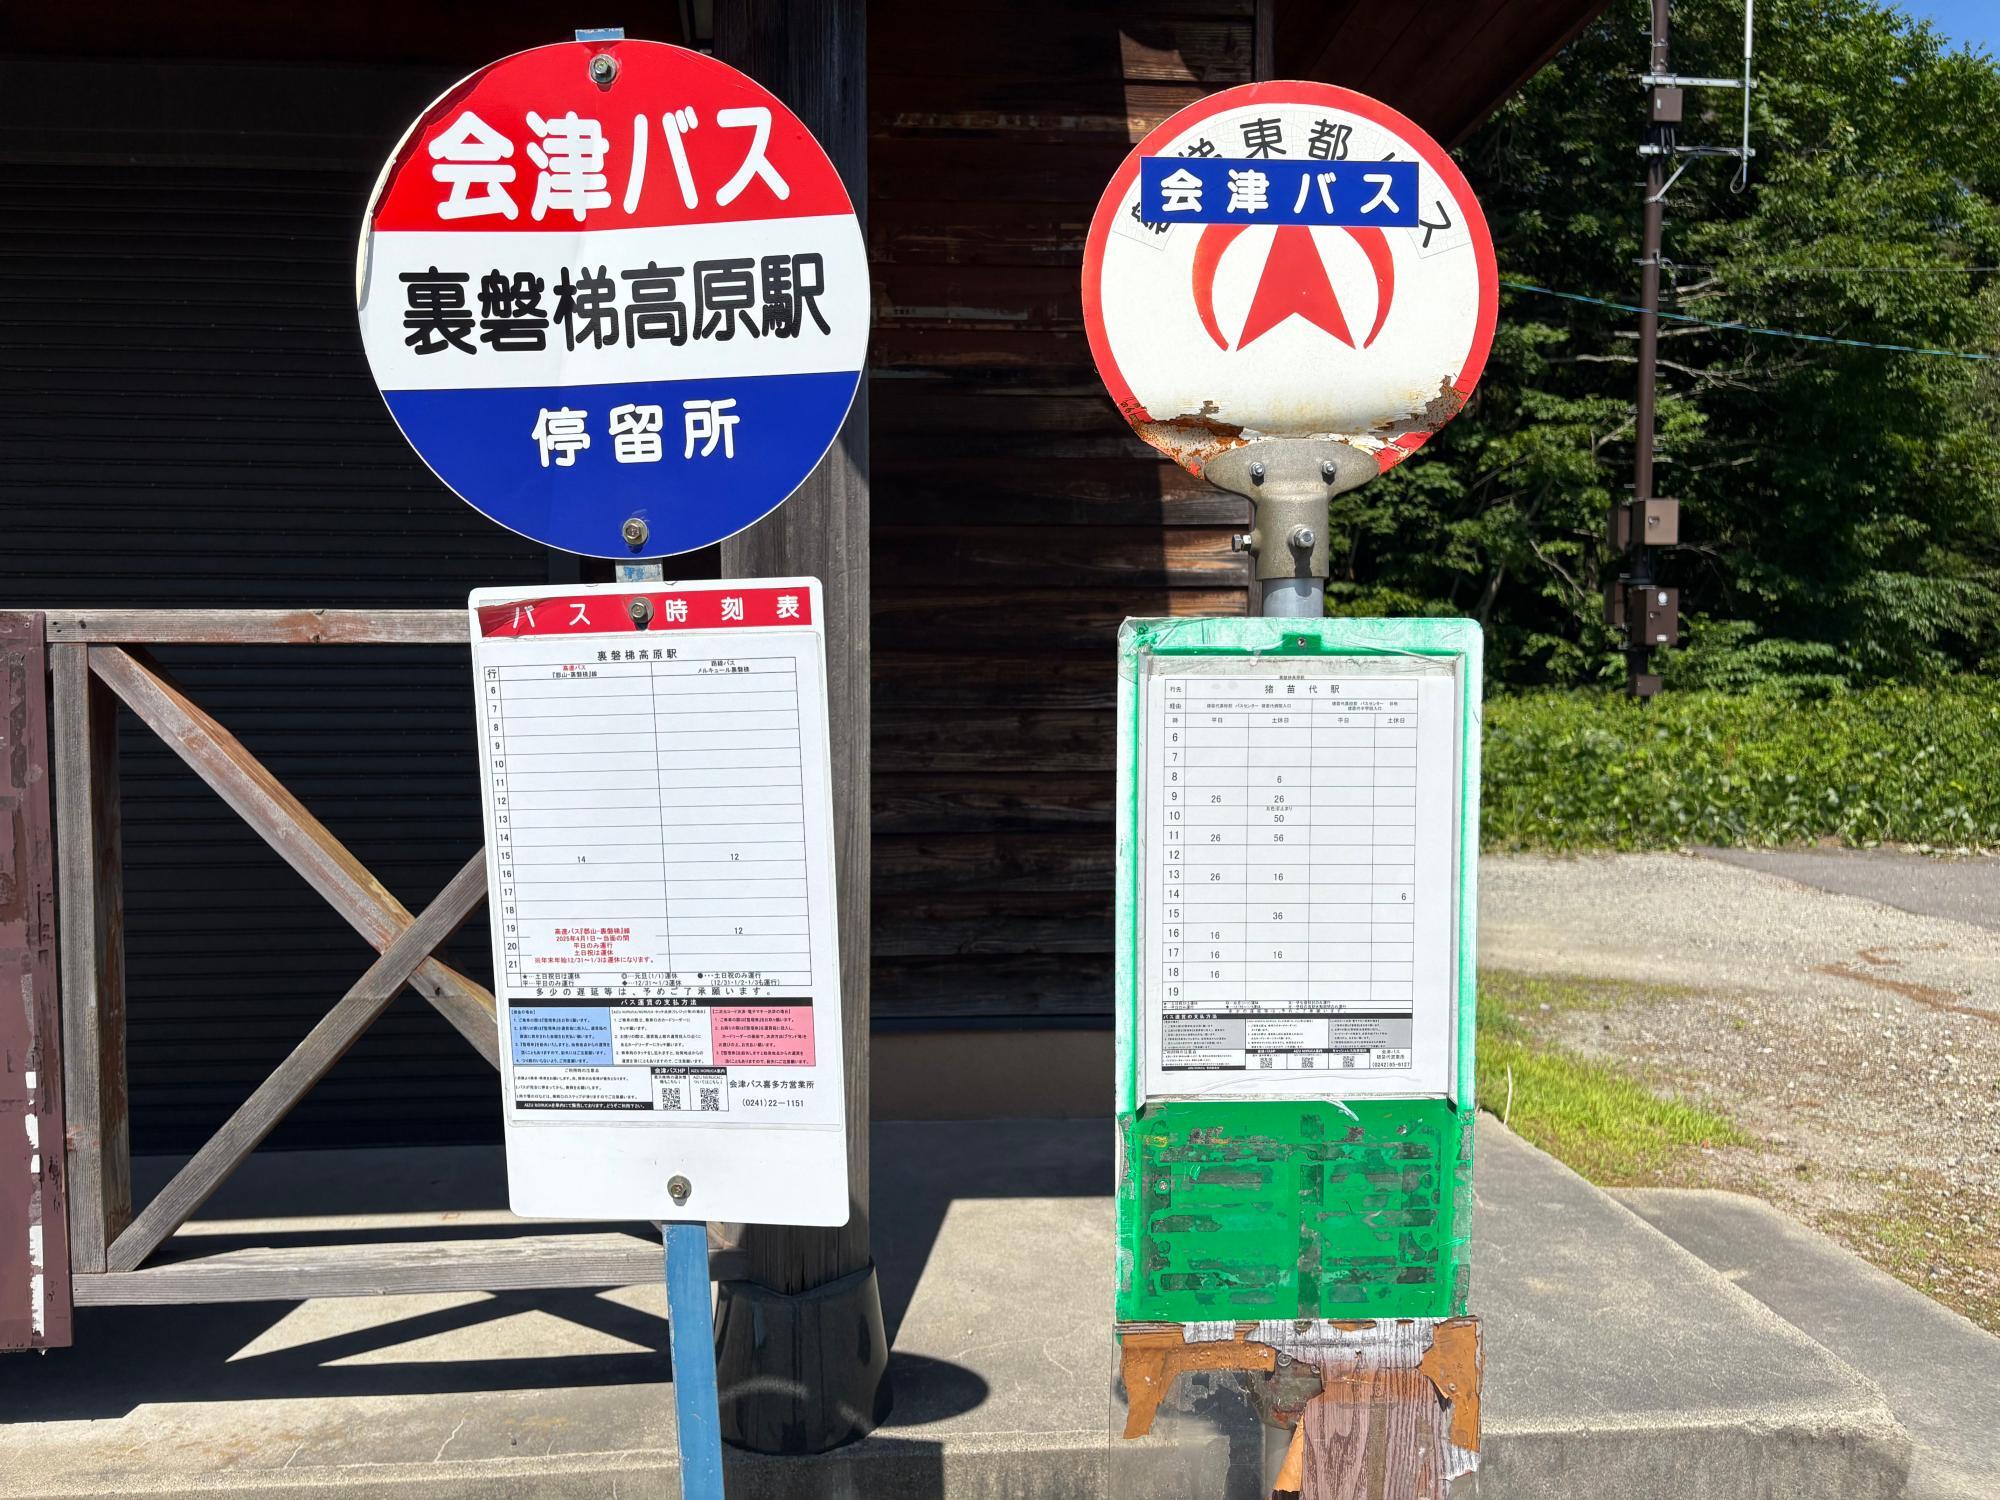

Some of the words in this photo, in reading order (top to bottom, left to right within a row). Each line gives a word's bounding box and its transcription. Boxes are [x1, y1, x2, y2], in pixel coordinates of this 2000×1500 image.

[429, 106, 790, 221] 会津バス
[1161, 169, 1399, 214] 会津バス
[399, 253, 830, 355] 裏磐梯高原駅
[532, 398, 740, 467] 停留所
[512, 595, 800, 629] バス時刻表
[597, 648, 678, 661] 裏磐梯高原駅
[488, 669, 497, 679] 行
[491, 686, 496, 694] 6
[1264, 684, 1340, 694] 猪苗代駅
[492, 705, 497, 713] 7
[494, 723, 499, 731] 8
[1172, 733, 1178, 742] 6
[495, 742, 500, 750] 9
[1172, 753, 1178, 762] 7
[495, 760, 503, 768] 10
[1172, 772, 1177, 781] 8
[496, 778, 505, 787] 11
[497, 797, 507, 805] 12
[1172, 792, 1177, 800] 9
[1211, 795, 1222, 803] 26
[1274, 795, 1284, 803] 26
[499, 815, 508, 823] 13
[1169, 811, 1180, 820] 10
[1274, 815, 1284, 823] 50
[500, 833, 509, 841] 14
[1169, 831, 1180, 840] 11
[1210, 834, 1221, 842] 26
[1274, 834, 1284, 842] 56
[501, 852, 510, 860] 15
[731, 853, 739, 861] 12
[1169, 850, 1180, 859] 12
[502, 870, 511, 878] 16
[1169, 870, 1180, 879] 13
[1210, 873, 1221, 881] 26
[1274, 873, 1284, 881] 16
[504, 888, 513, 896] 17
[1168, 889, 1179, 898] 14
[505, 906, 514, 914] 18
[1168, 909, 1179, 918] 15
[1272, 912, 1283, 920] 36
[507, 924, 516, 932] 19
[1168, 928, 1179, 937] 16
[1210, 931, 1220, 939] 16
[508, 942, 517, 950] 20
[1168, 948, 1179, 957] 17
[509, 960, 517, 968] 21
[1168, 967, 1179, 976] 18
[1210, 970, 1220, 978] 16
[1168, 987, 1179, 996] 19
[729, 1080, 814, 1089] 会津バス喜多方営業所
